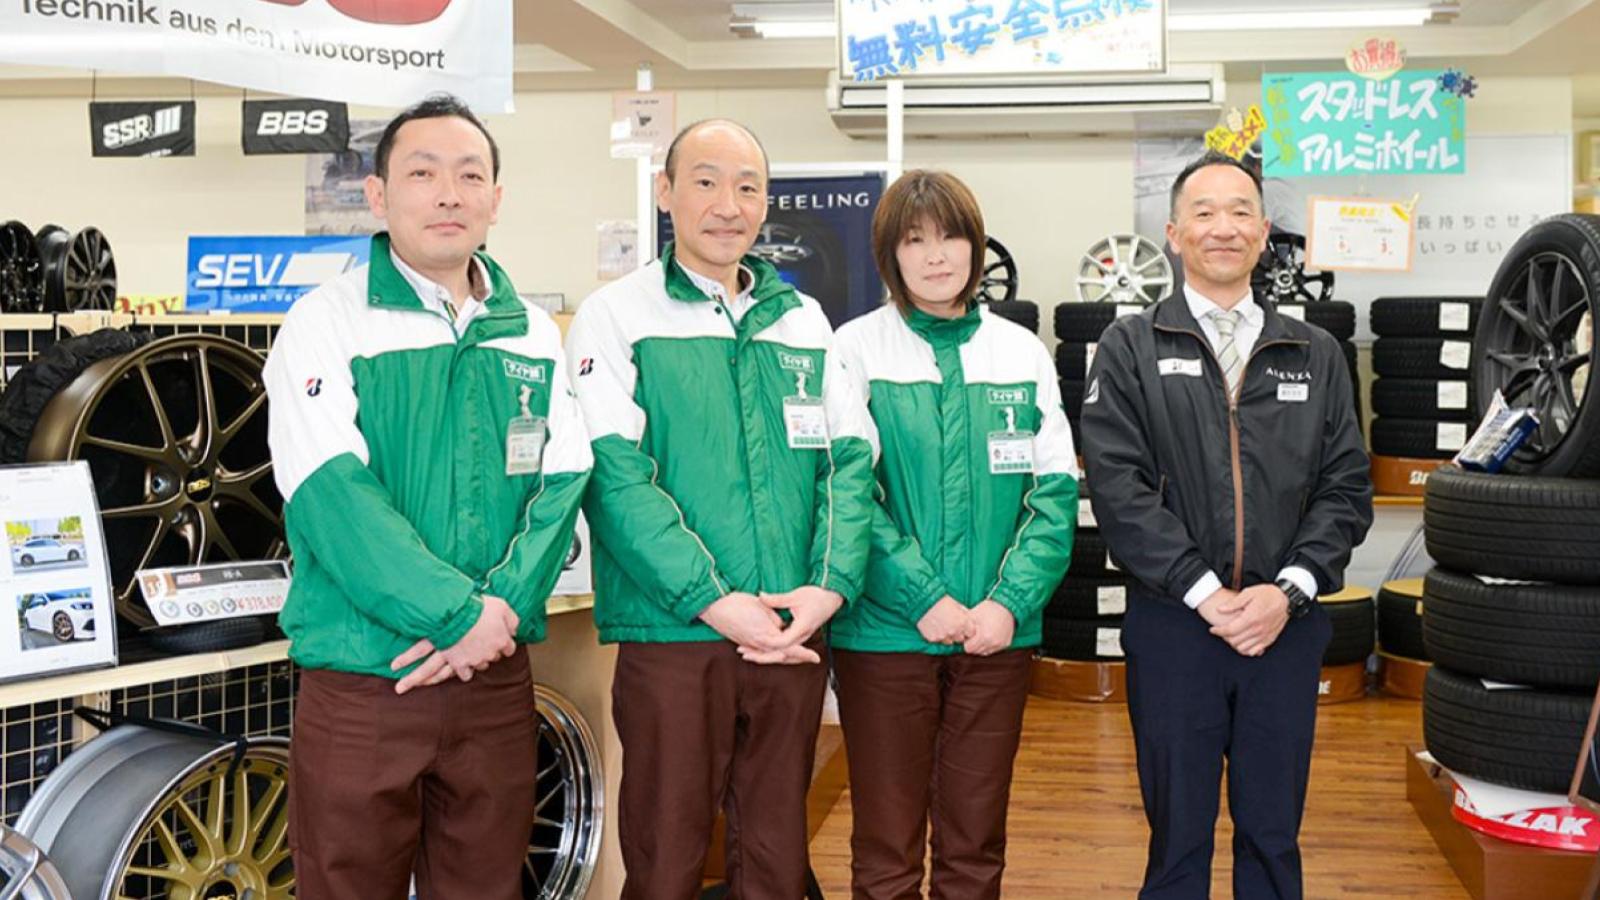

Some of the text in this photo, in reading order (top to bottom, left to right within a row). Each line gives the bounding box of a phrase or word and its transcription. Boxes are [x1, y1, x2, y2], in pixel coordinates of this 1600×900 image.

[169, 9, 218, 36] aus
[293, 31, 446, 70] Motorsport
[1297, 79, 1438, 122] スタッドレス
[102, 114, 153, 150] SSR
[256, 110, 330, 136] BBS
[1297, 129, 1459, 172] アルミホイール
[195, 254, 284, 287] SEV
